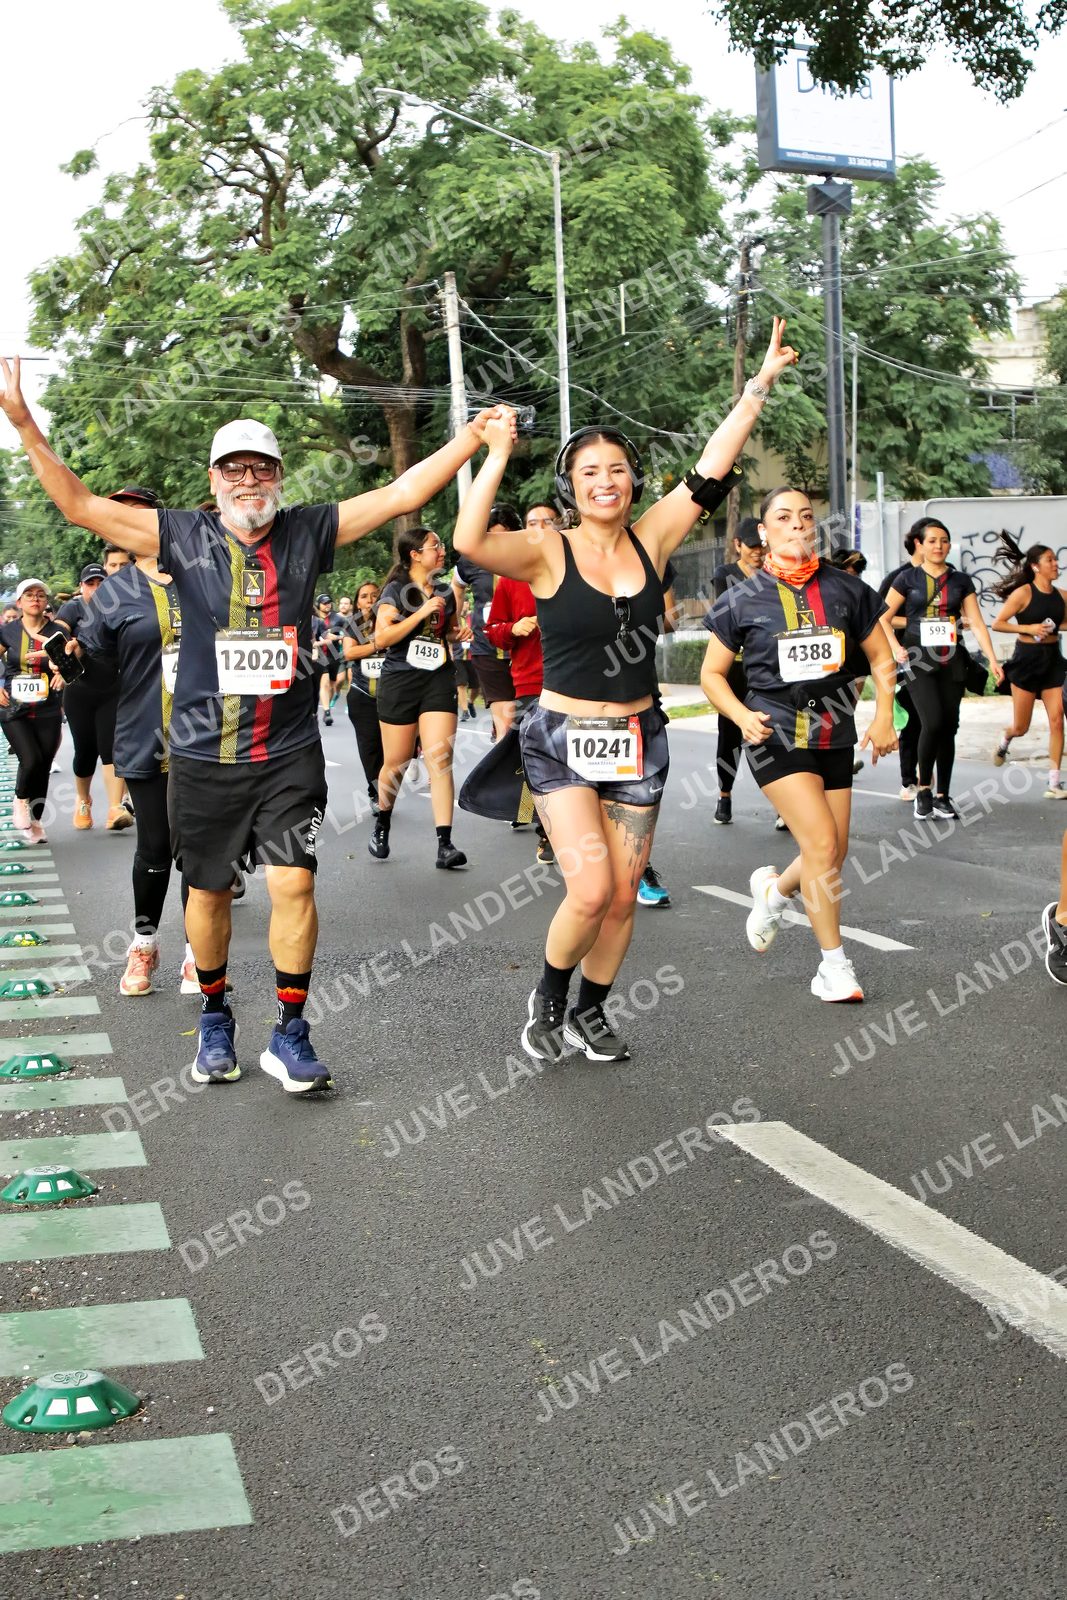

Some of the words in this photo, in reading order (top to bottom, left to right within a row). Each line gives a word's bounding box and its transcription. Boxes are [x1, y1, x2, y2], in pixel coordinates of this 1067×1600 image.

[929, 625, 946, 636] 593
[220, 649, 288, 670] 12020
[415, 644, 439, 659] 1438
[787, 642, 832, 662] 4388
[17, 683, 40, 692] 1701
[571, 737, 631, 758] 10241
